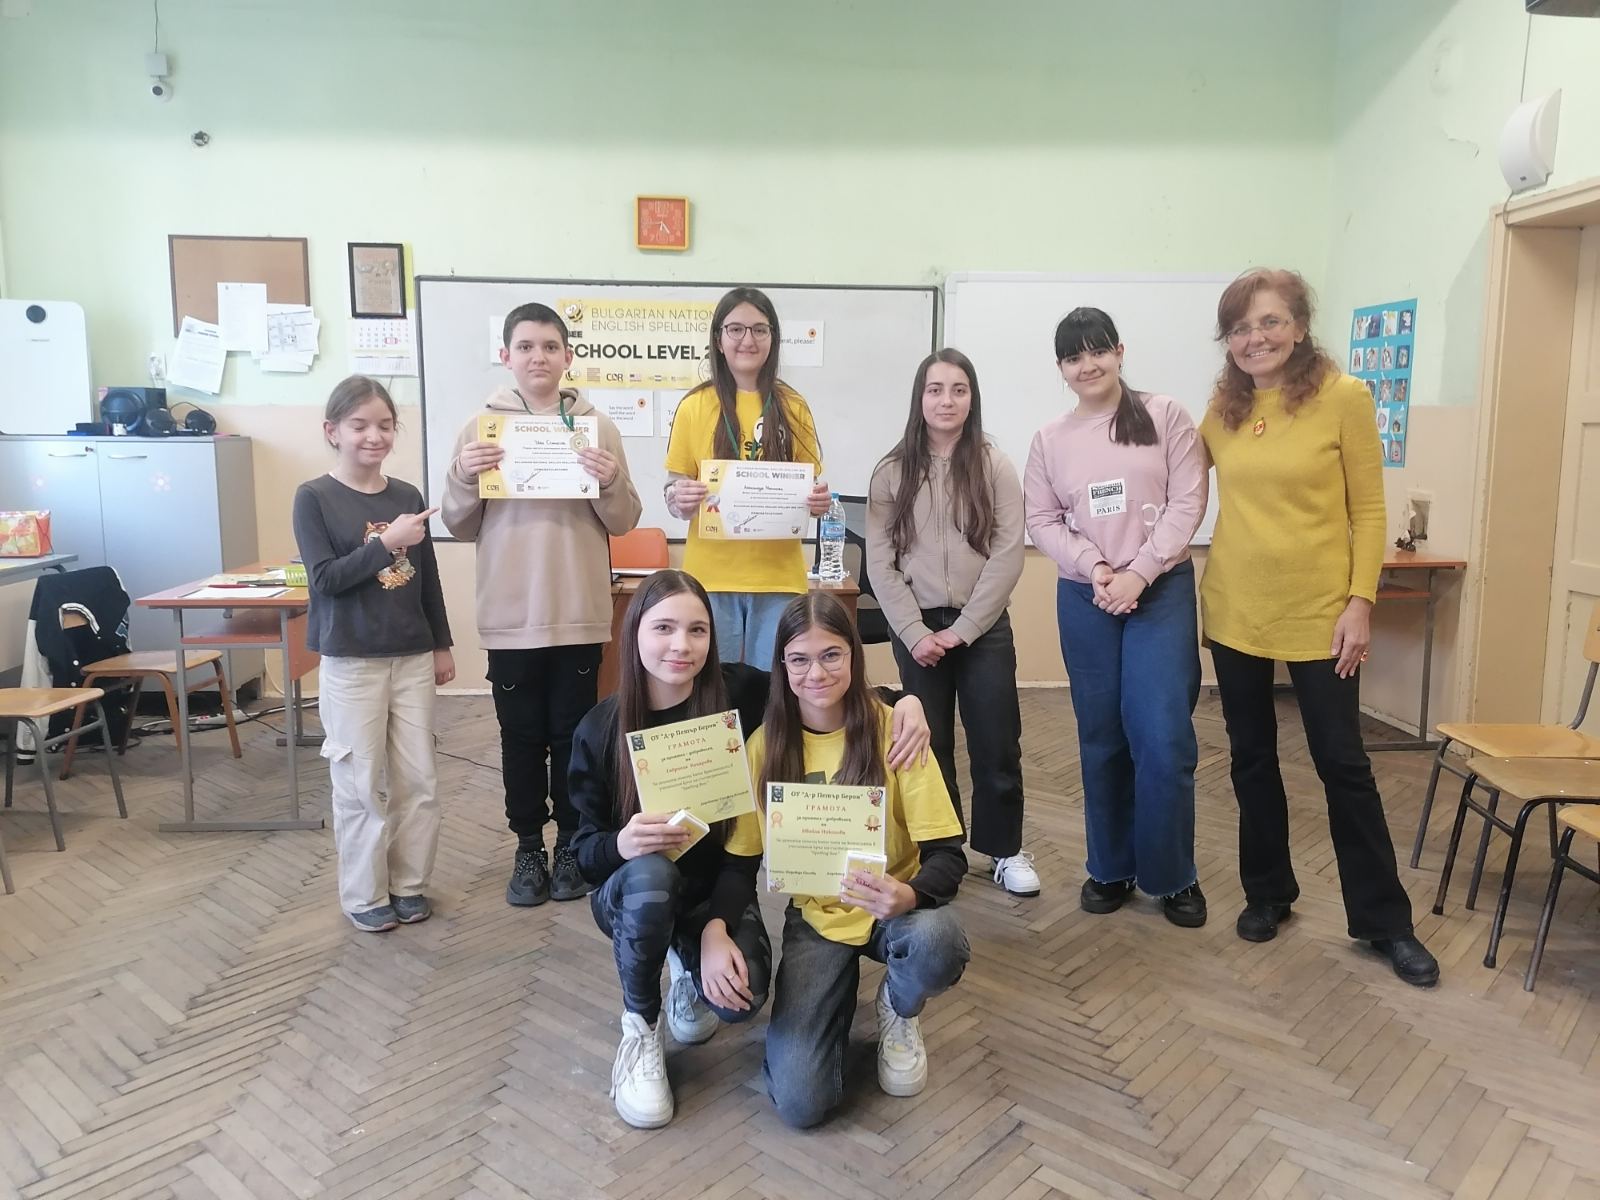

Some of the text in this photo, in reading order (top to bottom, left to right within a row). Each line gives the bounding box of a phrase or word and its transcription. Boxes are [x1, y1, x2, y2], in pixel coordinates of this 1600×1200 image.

[591, 308, 666, 320] BULGARIAN
[591, 320, 708, 333] ENGLISH SPELLING
[647, 344, 700, 360] LEVEL
[735, 471, 805, 480] SCHOOL WINNER
[1096, 505, 1121, 515] PARIS
[667, 737, 707, 750] ГРАМОТА
[806, 804, 847, 812] ГРАМОТА
